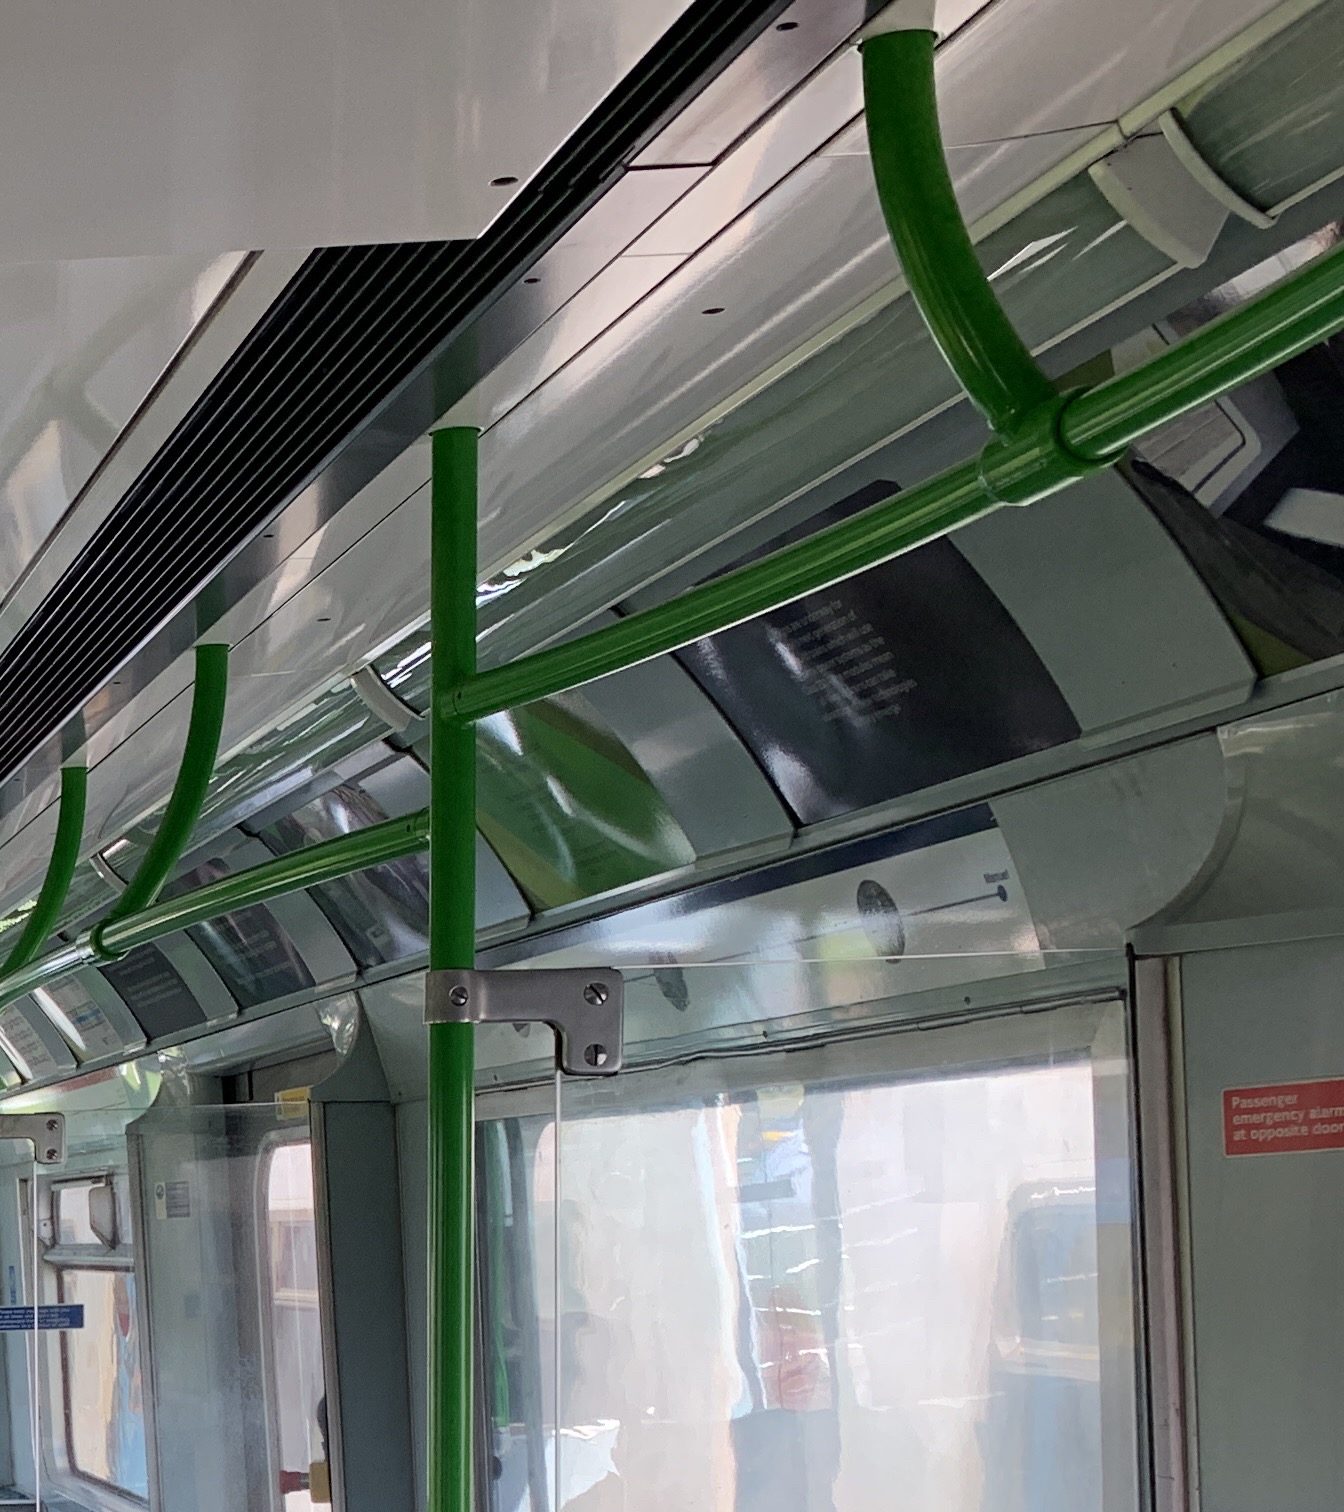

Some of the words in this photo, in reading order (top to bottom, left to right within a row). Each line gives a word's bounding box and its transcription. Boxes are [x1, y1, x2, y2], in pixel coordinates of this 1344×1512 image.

[1232, 1094, 1298, 1109] Passenger
[1233, 1110, 1305, 1124] emergency
[1233, 1130, 1247, 1141] at
[1250, 1125, 1309, 1142] opposite
